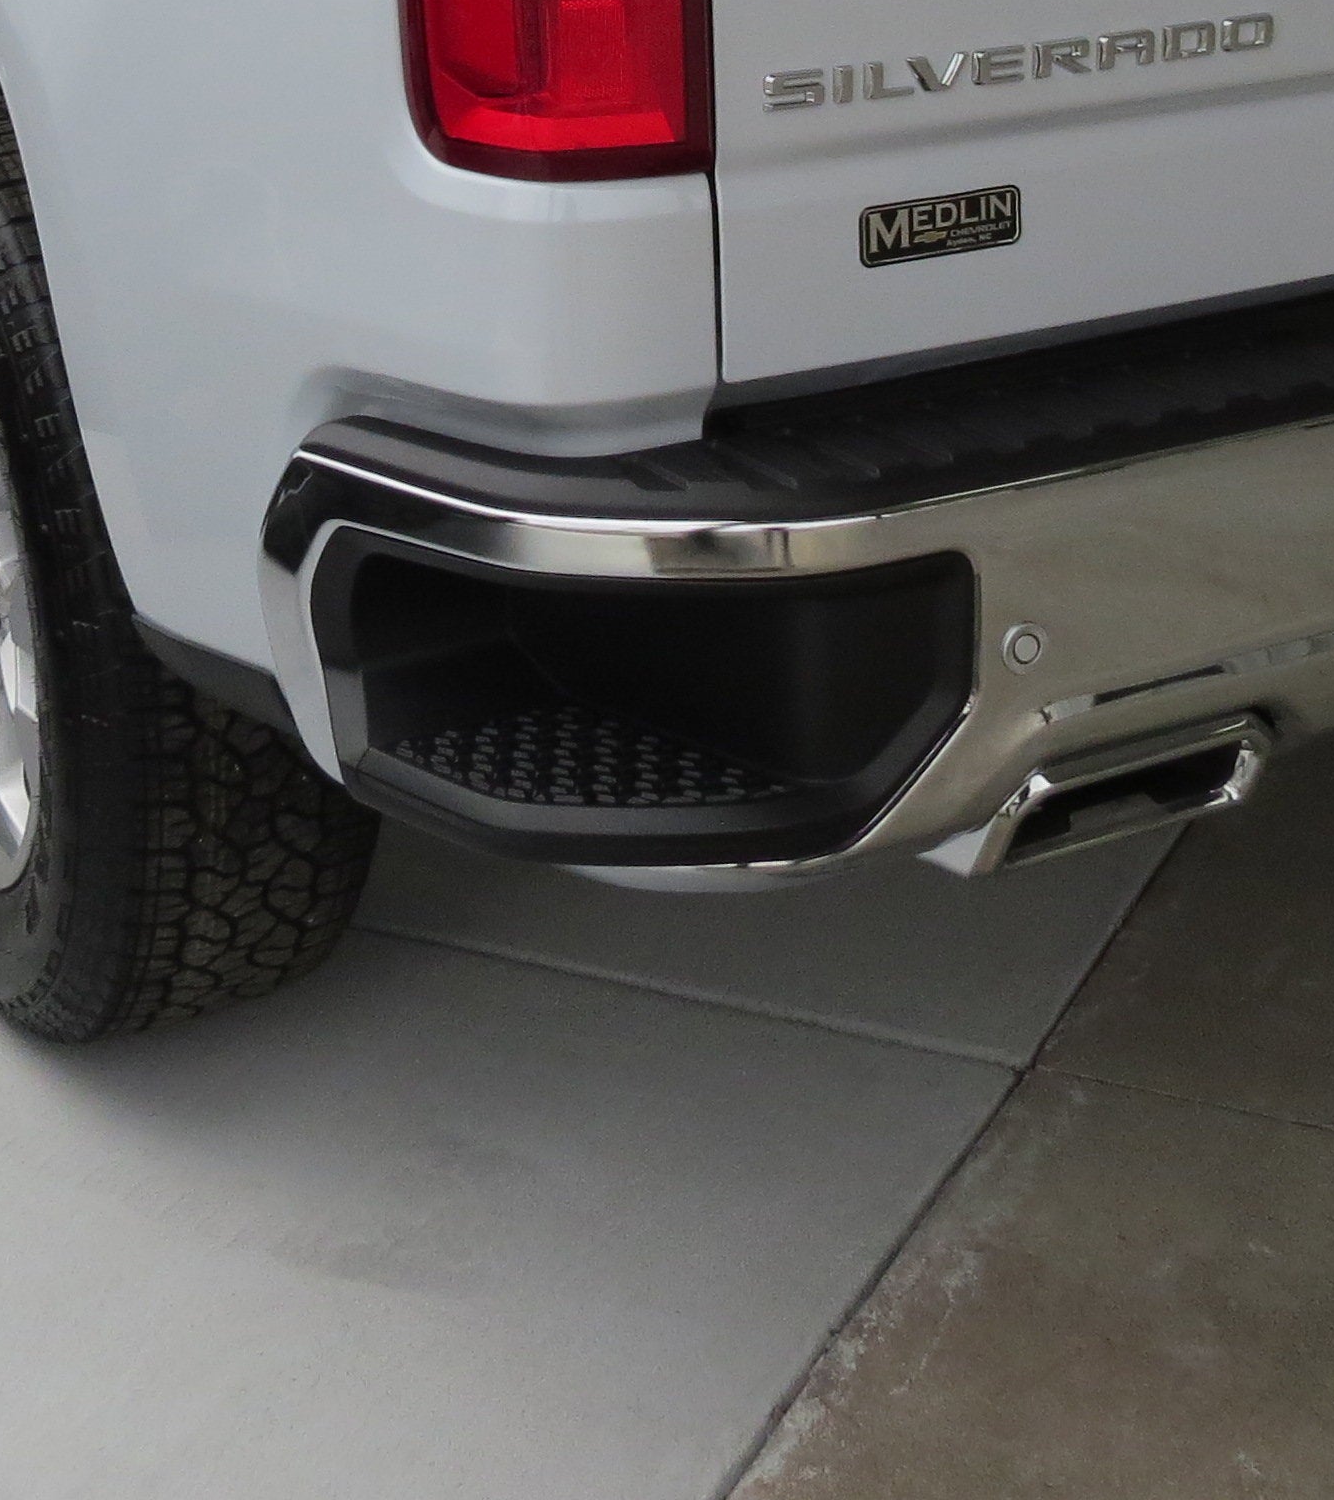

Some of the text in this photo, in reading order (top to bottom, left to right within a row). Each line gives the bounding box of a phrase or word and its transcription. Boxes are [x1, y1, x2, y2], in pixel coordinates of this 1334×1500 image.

[762, 12, 1275, 113] SILVERADO
[868, 192, 1013, 254] MEDLIN
[949, 220, 1012, 238] CHEVROLET
